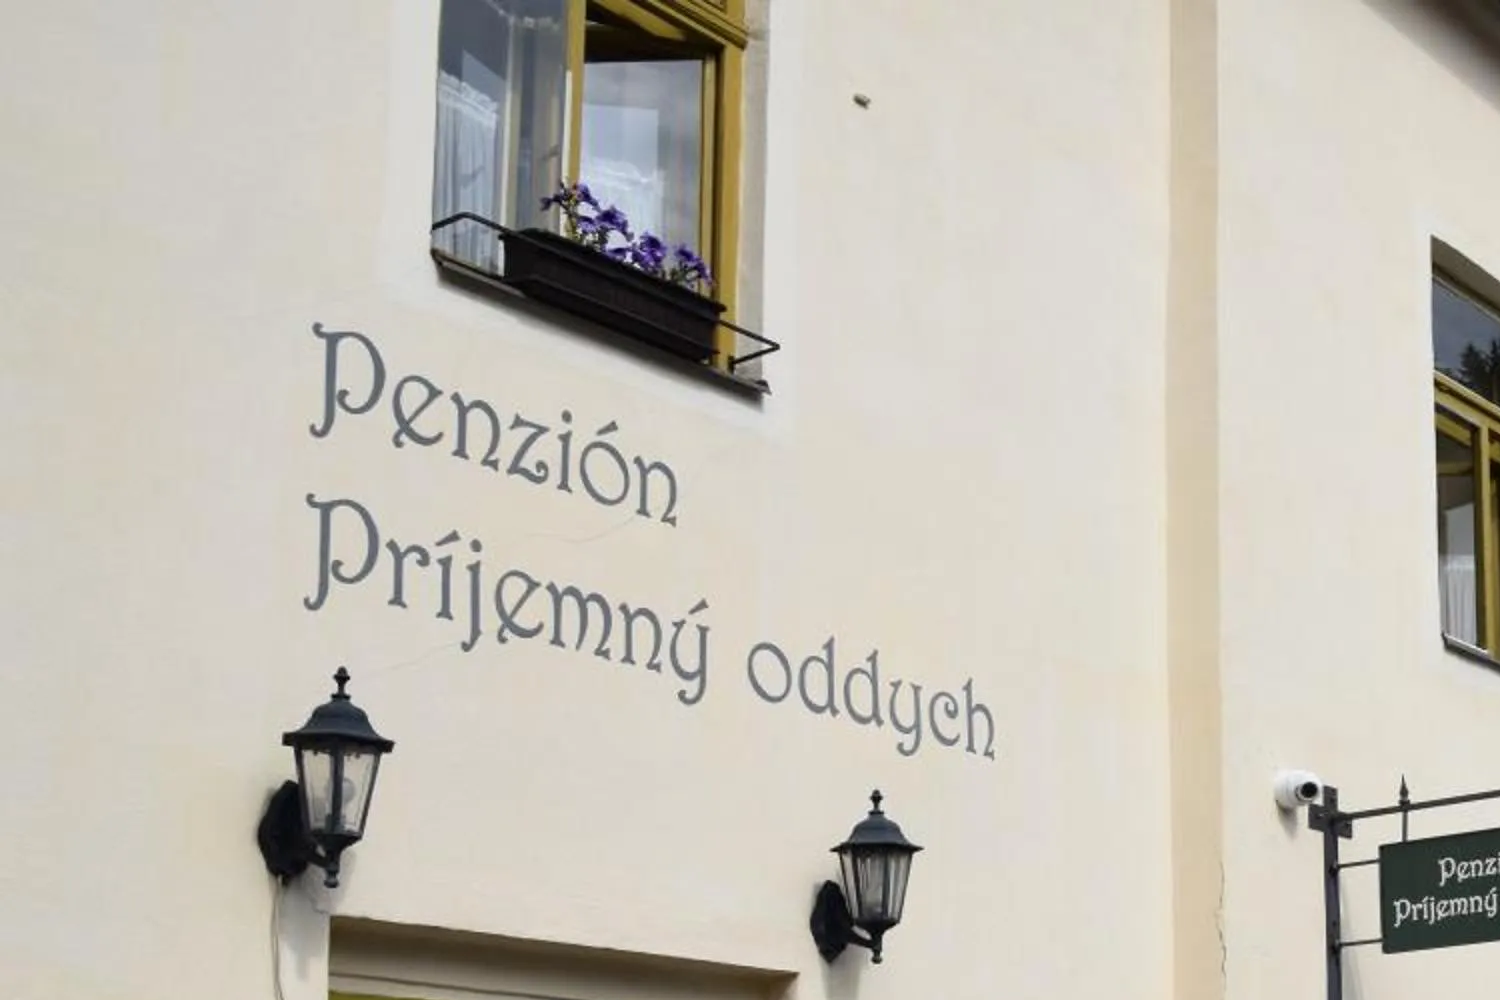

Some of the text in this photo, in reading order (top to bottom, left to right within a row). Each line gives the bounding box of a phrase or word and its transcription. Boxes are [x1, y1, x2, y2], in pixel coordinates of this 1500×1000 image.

[309, 322, 678, 527] Penzión
[303, 493, 996, 761] Príjemný oddych
[1393, 887, 1498, 927] Príjemný
